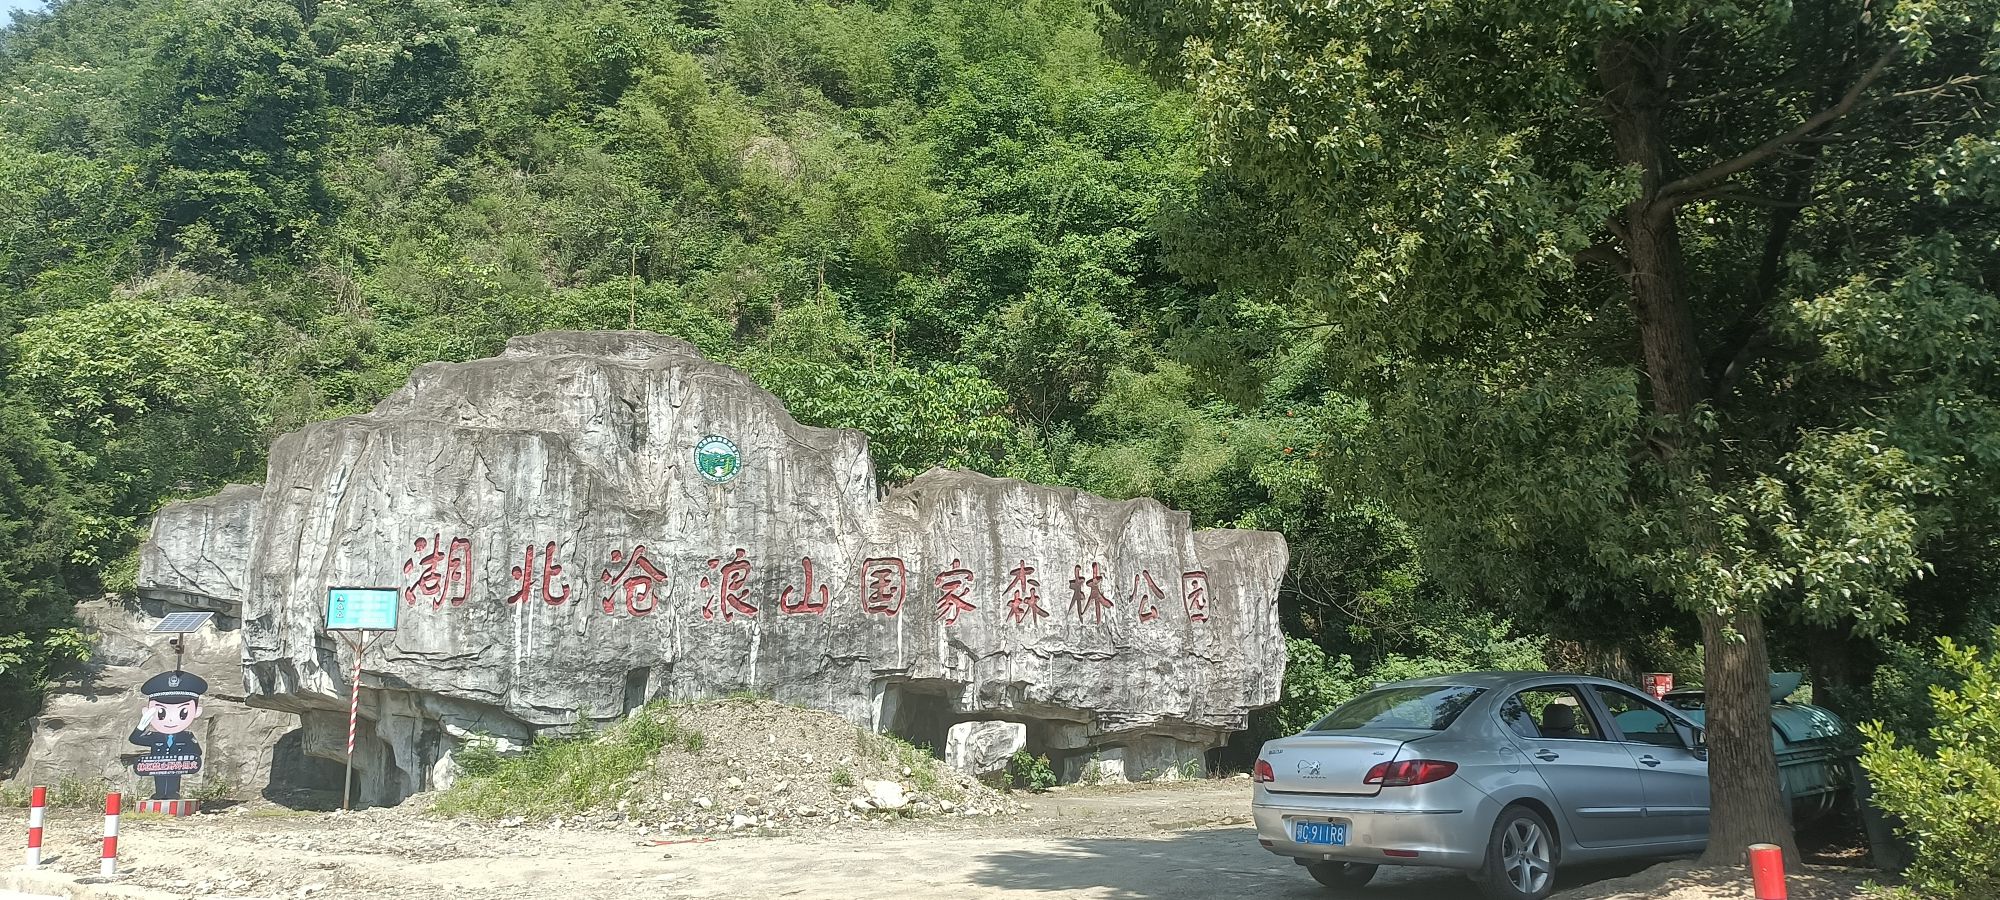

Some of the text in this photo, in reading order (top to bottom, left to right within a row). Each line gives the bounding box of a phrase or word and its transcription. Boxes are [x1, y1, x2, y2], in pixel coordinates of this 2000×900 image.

[403, 533, 1209, 624] 湖北沧浪山国家森林公园
